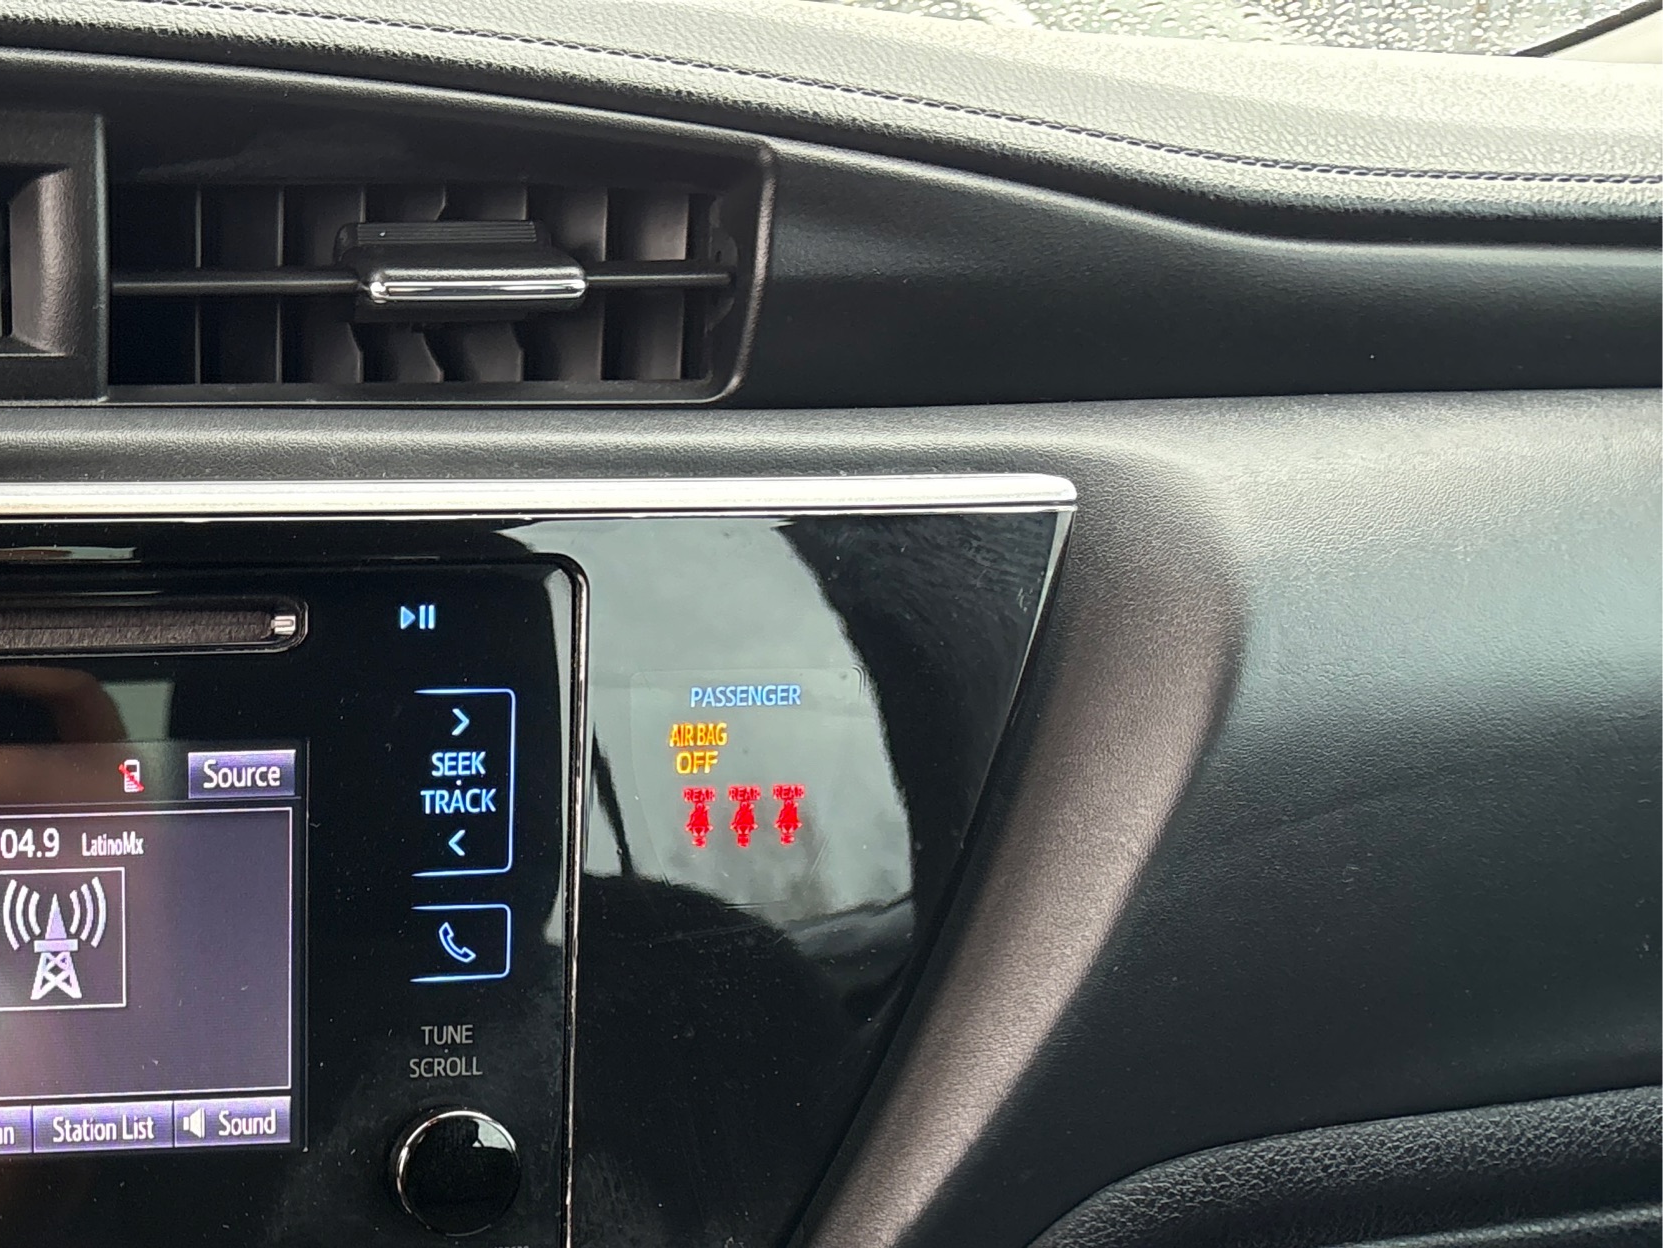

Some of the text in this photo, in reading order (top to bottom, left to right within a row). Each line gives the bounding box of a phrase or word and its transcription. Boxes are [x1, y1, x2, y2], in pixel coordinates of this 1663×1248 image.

[689, 684, 802, 708] PASSENGER
[668, 722, 729, 748] AIR BAG
[202, 759, 281, 789] Source
[431, 750, 486, 778] SEEK
[675, 750, 720, 775] OFF
[420, 786, 496, 815] TRACK
[684, 786, 716, 802] REAR
[728, 785, 761, 801] REAR
[772, 784, 805, 800] REAR
[81, 831, 145, 858] LatinoMx
[421, 1025, 473, 1046] TUNE
[409, 1057, 483, 1078] SCROLL
[51, 1114, 155, 1144] Station List
[217, 1109, 277, 1138] Sound
